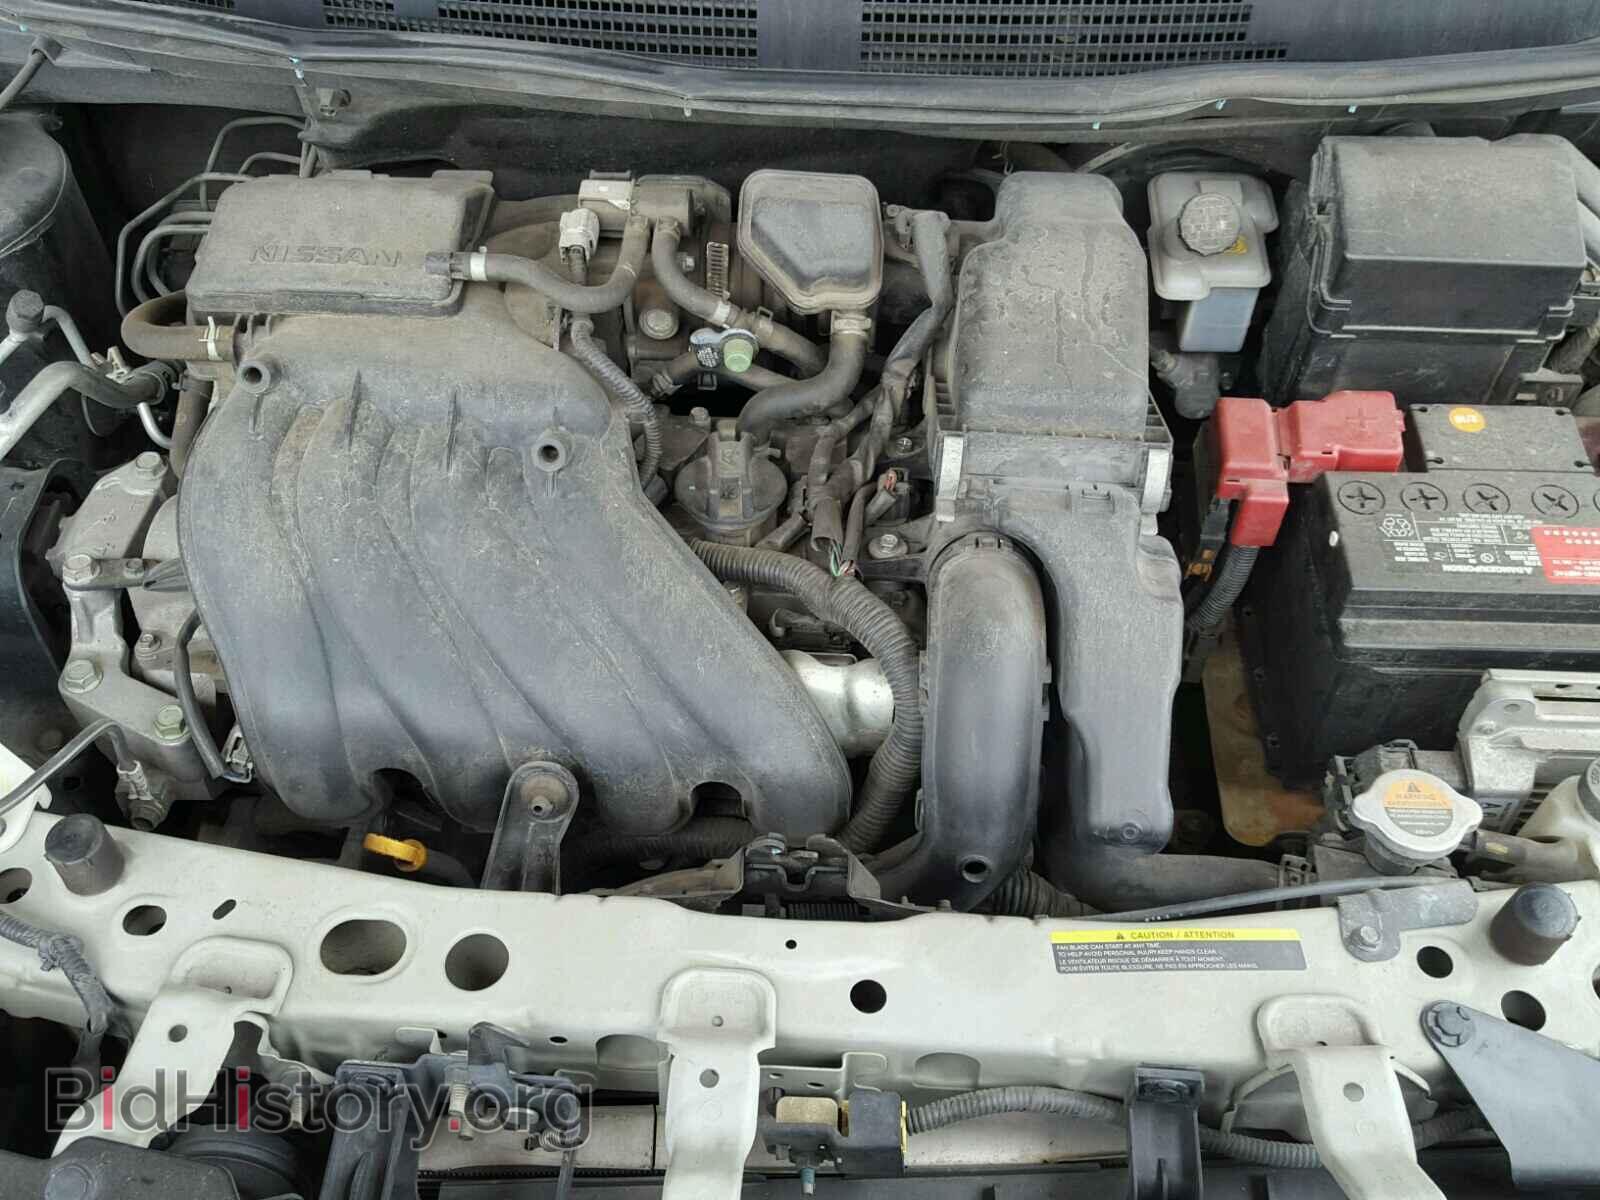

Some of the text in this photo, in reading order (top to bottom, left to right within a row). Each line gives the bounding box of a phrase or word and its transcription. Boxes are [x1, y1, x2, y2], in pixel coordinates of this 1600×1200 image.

[249, 245, 401, 267] NISSAN
[1130, 931, 1173, 939] CAUTION
[1183, 930, 1235, 939] ATTENTION
